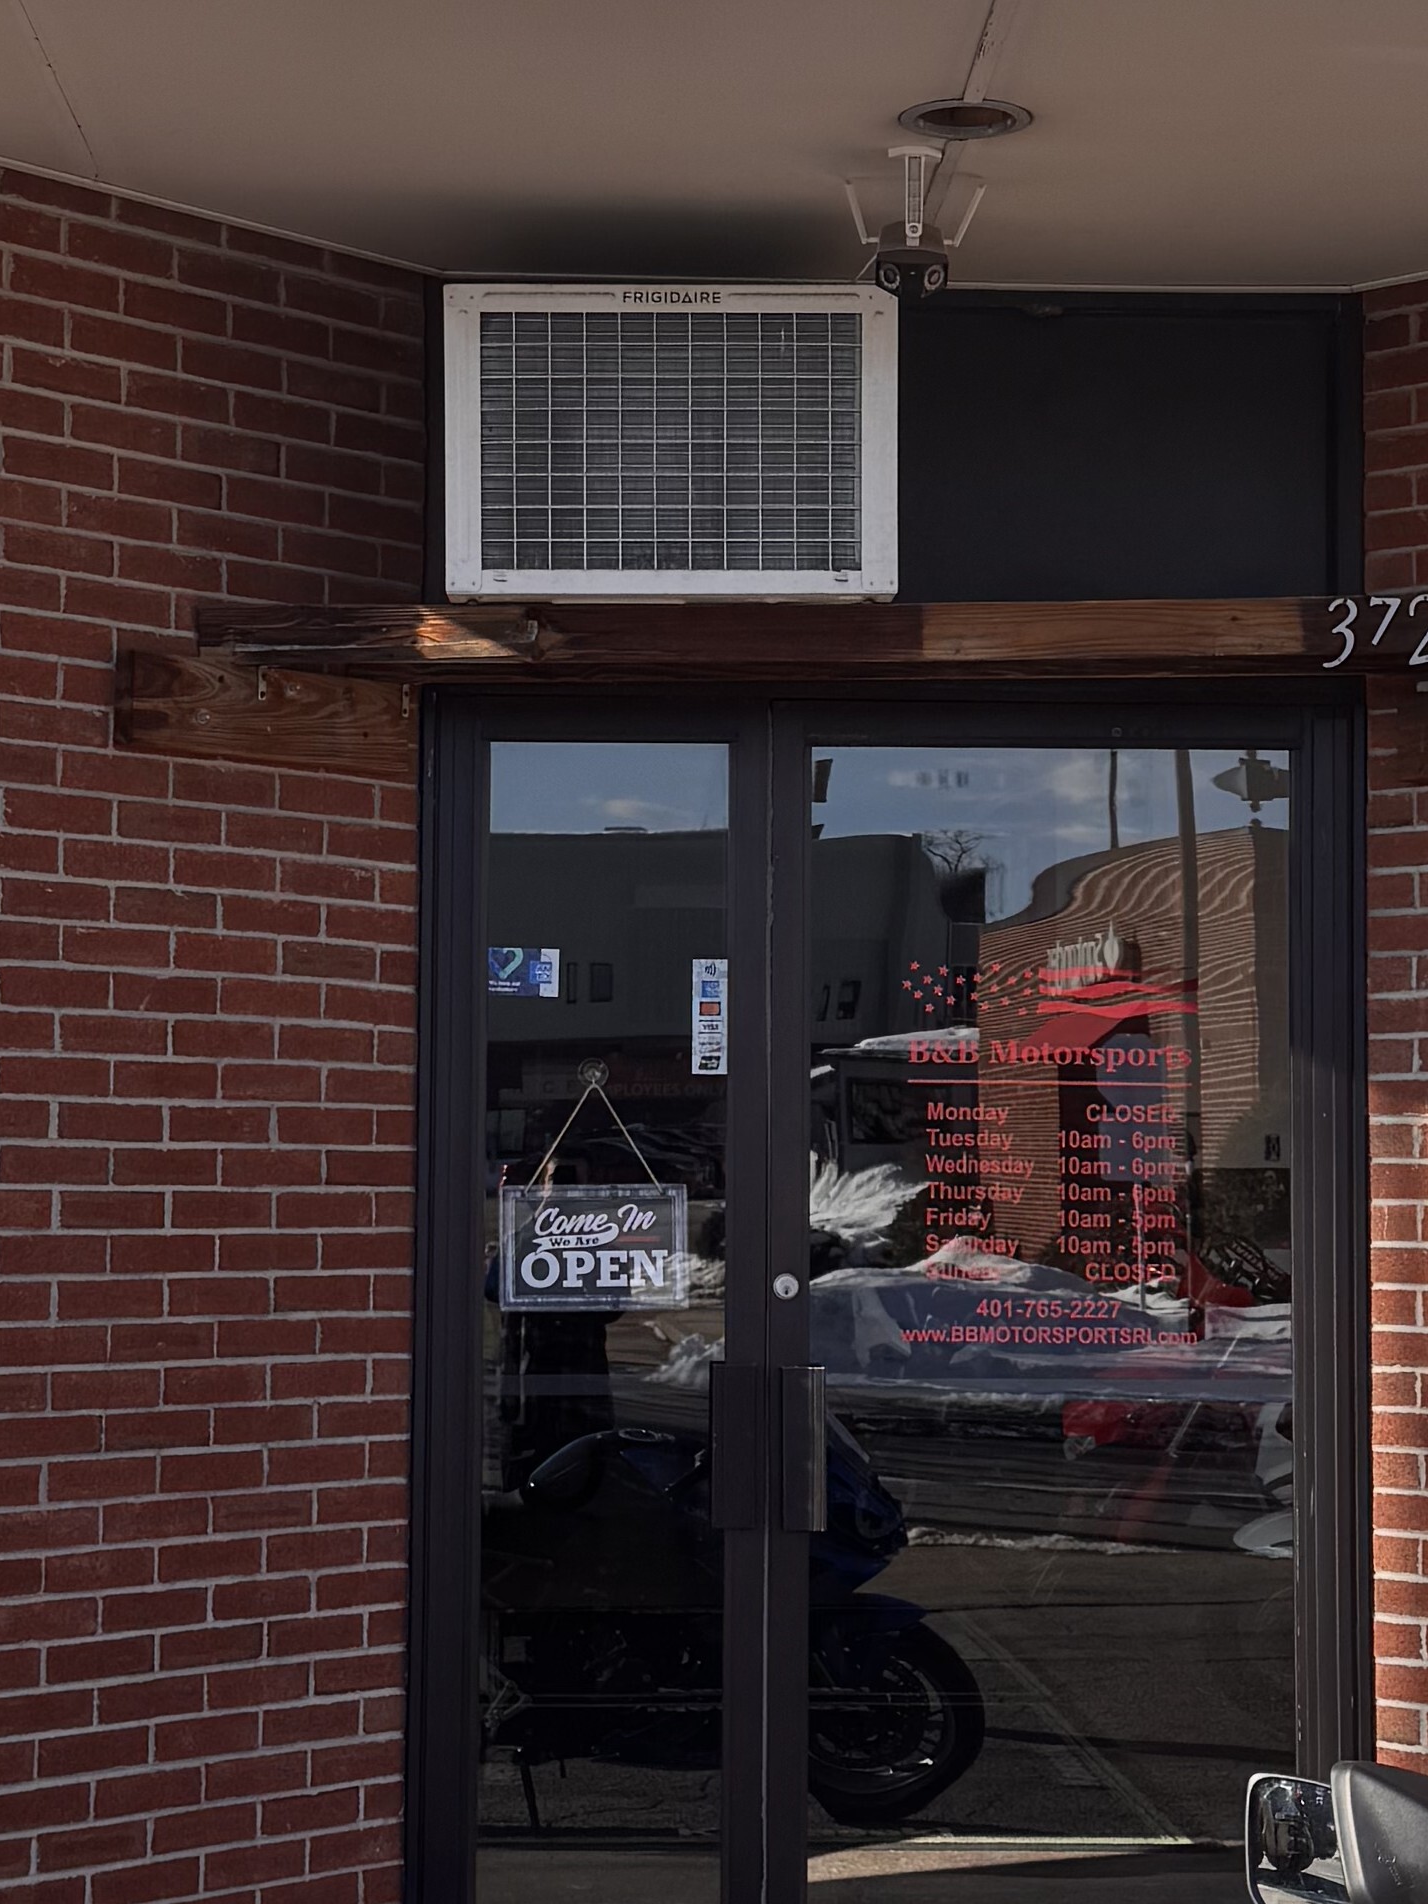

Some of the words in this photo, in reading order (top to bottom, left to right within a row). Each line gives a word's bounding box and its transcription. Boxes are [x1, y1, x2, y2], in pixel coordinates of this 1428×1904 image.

[621, 290, 722, 304] FRIGIDAIRE
[907, 1039, 980, 1064] B&B
[988, 1039, 1192, 1073] Motorsports
[927, 1101, 1009, 1125] Monday
[1085, 1103, 1177, 1123] CLOSED
[926, 1127, 1014, 1150] Tuesday
[1057, 1130, 1112, 1148] 10am
[1131, 1131, 1177, 1153] 6pm
[925, 1152, 1035, 1179] Wednesday
[1057, 1157, 1112, 1175] 10am
[1131, 1157, 1177, 1179] 6pm
[926, 1181, 1025, 1204] Thursday
[1057, 1183, 1112, 1201] 10am
[1131, 1183, 1177, 1206] 6pm
[534, 1207, 614, 1237] Come
[617, 1203, 657, 1233] In
[925, 1207, 992, 1231] Friday
[1057, 1209, 1112, 1228] 10am
[1131, 1209, 1177, 1232] 5pm
[549, 1236, 571, 1247] We
[575, 1236, 599, 1247] Are
[1057, 1235, 1112, 1254] 10am
[1131, 1236, 1177, 1258] 5pm
[520, 1249, 668, 1289] OPEN
[1084, 1262, 1176, 1282] CLOSED
[975, 1297, 1123, 1319] 401-765-2227
[900, 1325, 1198, 1347] www.BBMOTORSPORTSRI.com
